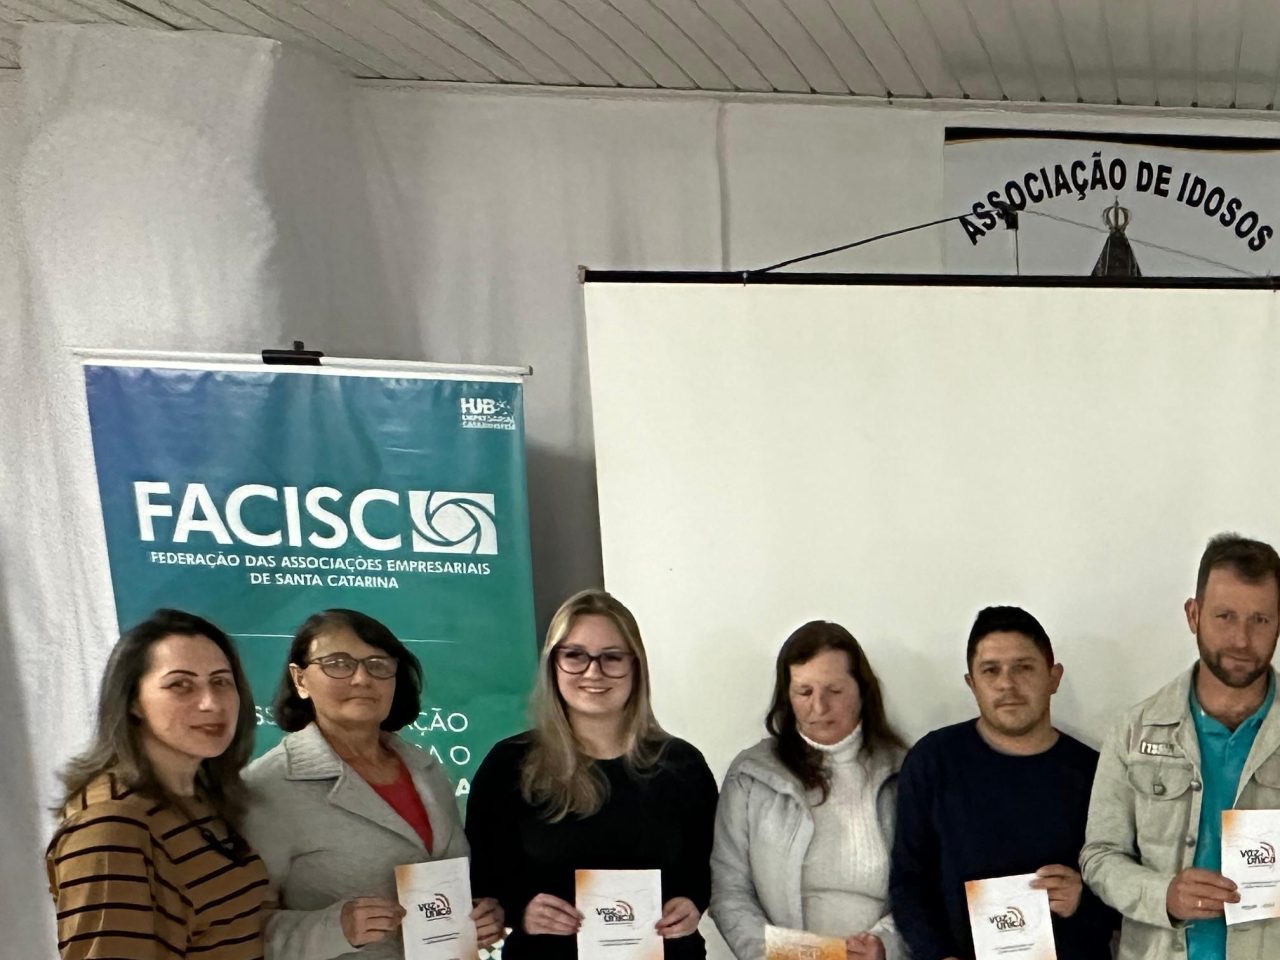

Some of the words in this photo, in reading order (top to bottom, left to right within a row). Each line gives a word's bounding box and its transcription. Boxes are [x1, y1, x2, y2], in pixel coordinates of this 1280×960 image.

[957, 151, 1127, 246] ASSOCIAÇÃO
[1136, 160, 1173, 198] DE
[1176, 172, 1274, 252] IDOSOS
[460, 397, 496, 414] HUB
[133, 480, 402, 551] FACISC
[150, 551, 240, 569] FEDERAÇÃO
[244, 555, 277, 568] DAS
[281, 555, 383, 573] ASSOCIAÇÕES
[387, 559, 491, 575] EMPRESARIAIS
[249, 572, 272, 585] DE
[275, 573, 323, 587] SANTA
[326, 574, 400, 589] CATARINA
